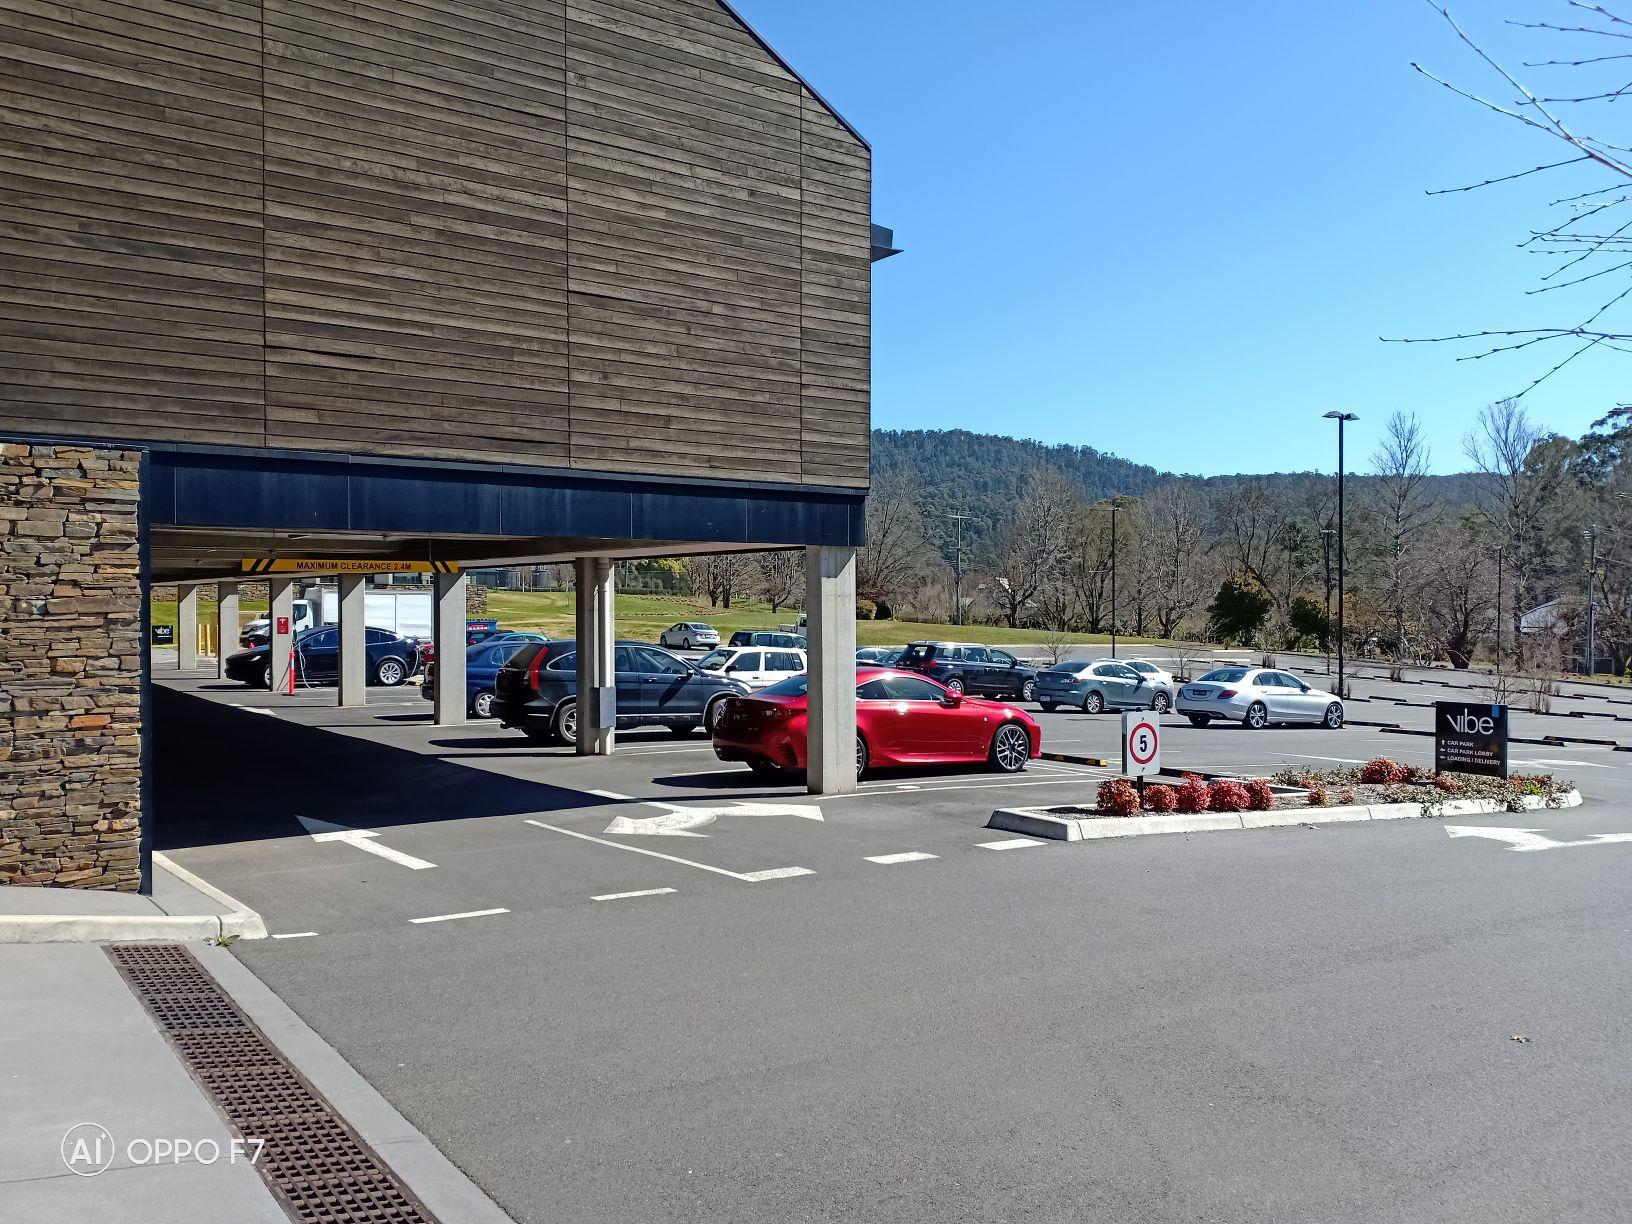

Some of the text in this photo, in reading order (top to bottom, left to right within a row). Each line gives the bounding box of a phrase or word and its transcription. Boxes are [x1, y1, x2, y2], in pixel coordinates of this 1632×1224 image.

[296, 561, 412, 571] MAXIMUM CLEARANCE 2.4M
[1446, 708, 1494, 735] vibe
[1140, 734, 1148, 752] 5
